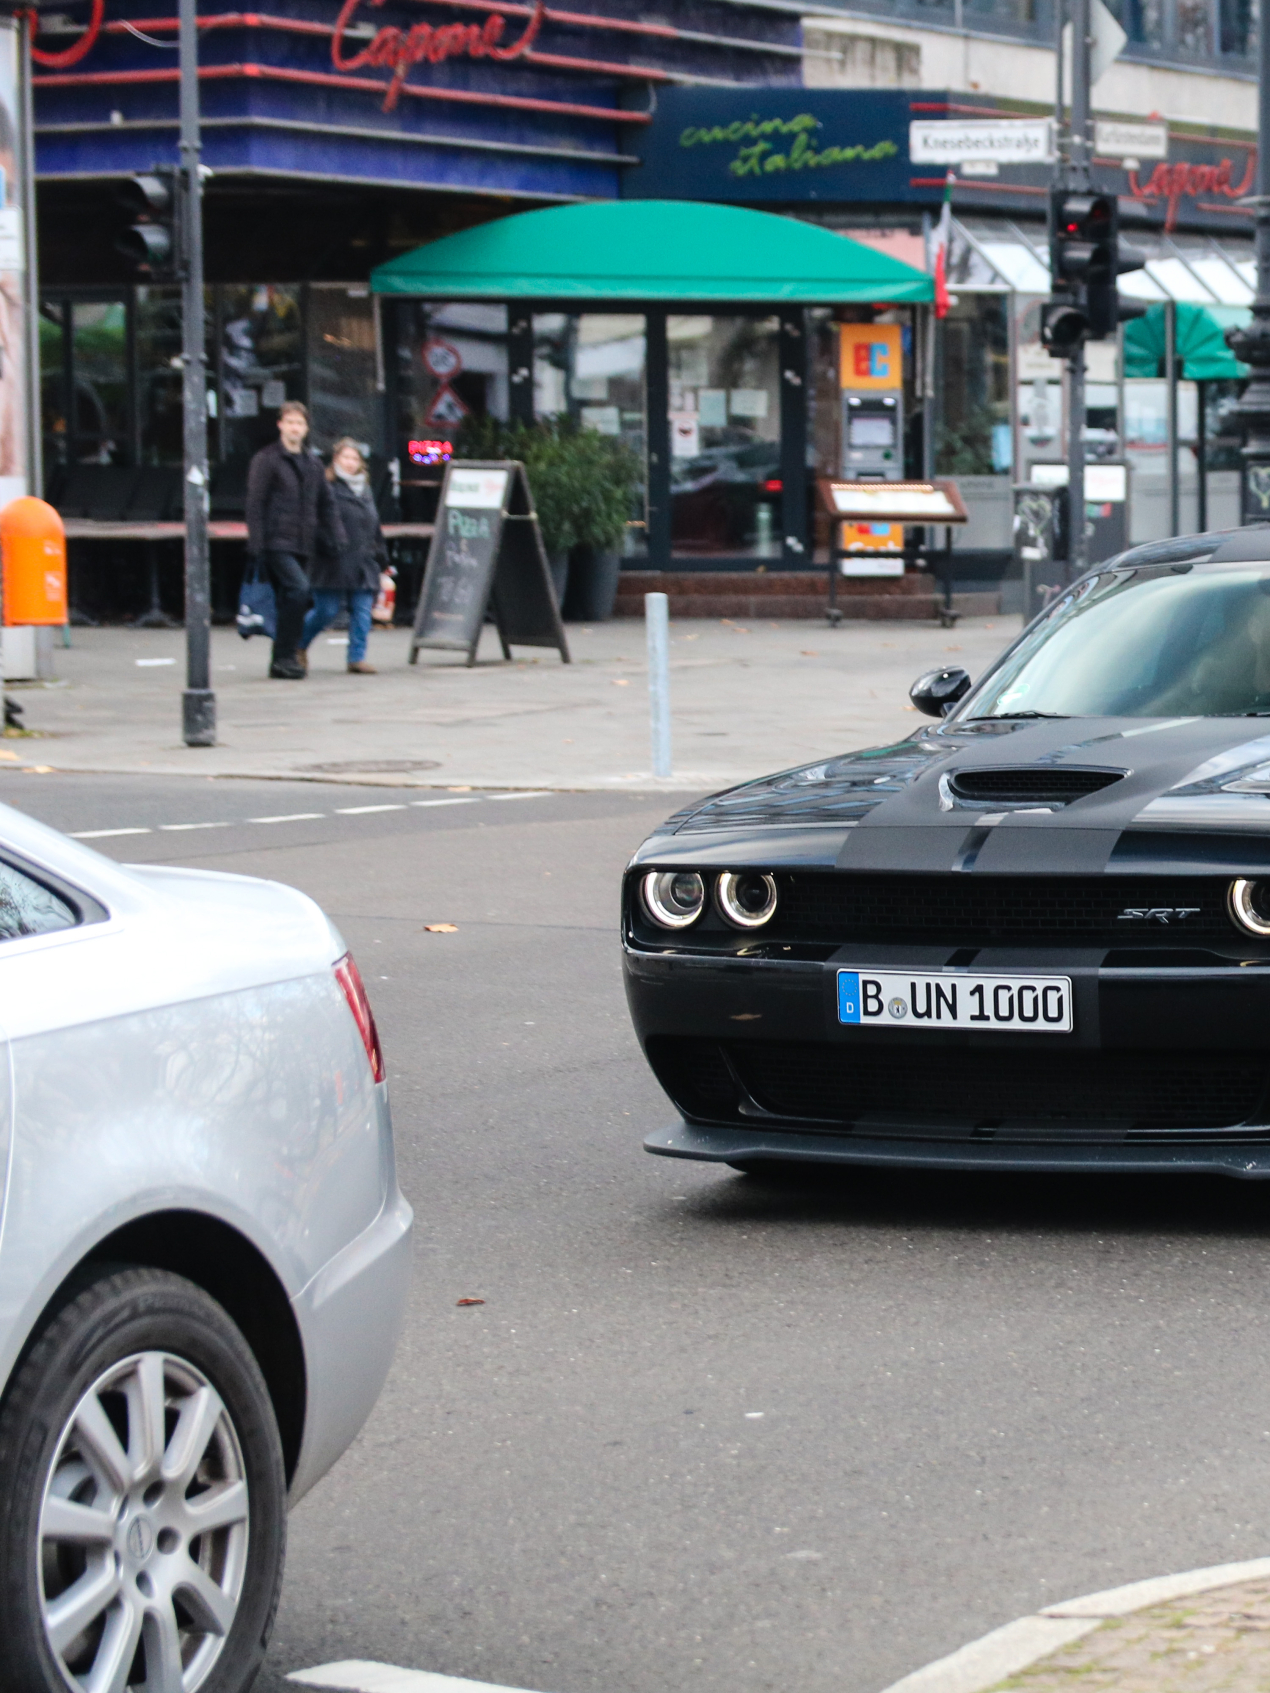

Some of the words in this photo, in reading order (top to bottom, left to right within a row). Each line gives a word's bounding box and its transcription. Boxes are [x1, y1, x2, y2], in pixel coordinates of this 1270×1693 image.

[922, 132, 1040, 152] Knesebeckstraße
[1117, 908, 1200, 923] SRT
[862, 980, 884, 1017] B
[910, 981, 957, 1020] UN
[969, 984, 1065, 1023] 1000
